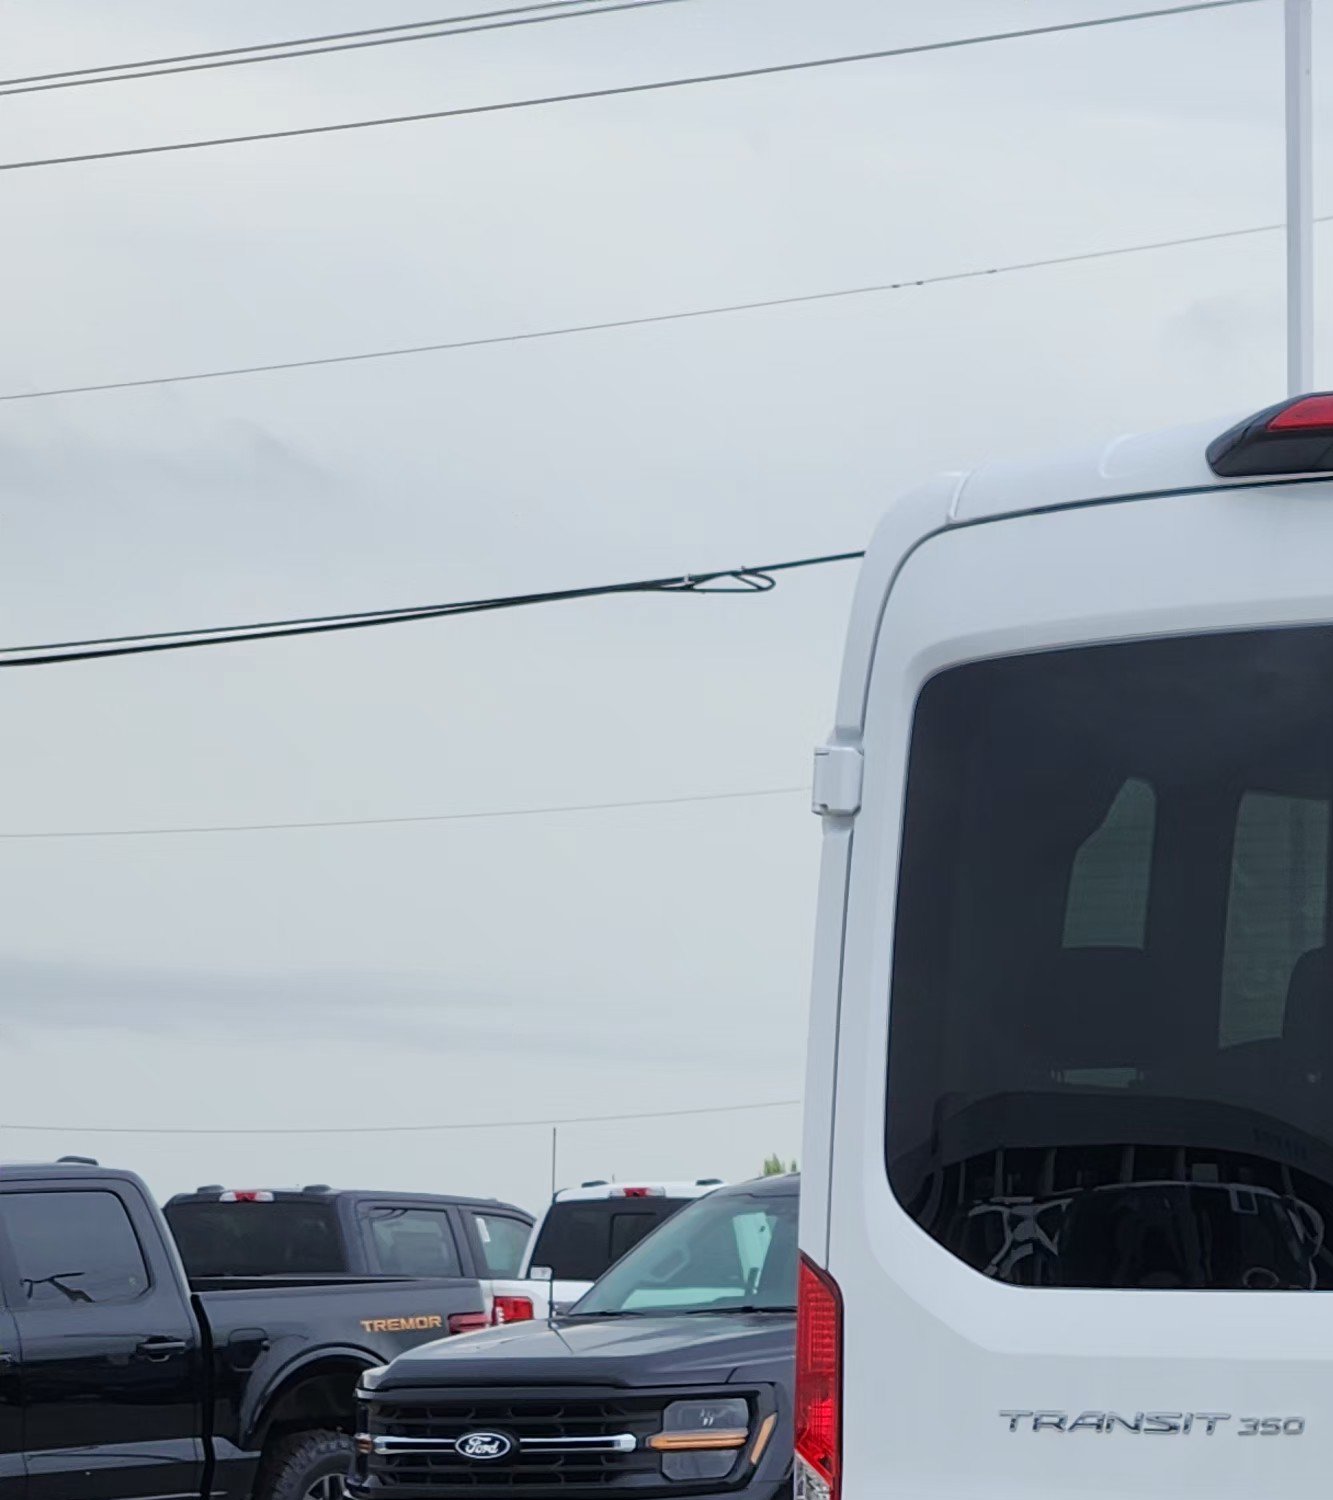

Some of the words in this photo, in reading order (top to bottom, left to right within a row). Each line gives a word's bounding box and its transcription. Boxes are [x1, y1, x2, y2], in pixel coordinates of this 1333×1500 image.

[361, 1316, 442, 1332] TREMOR
[1000, 1410, 1230, 1435] TRANSIT
[1238, 1417, 1304, 1436] 350
[465, 1436, 499, 1454] Ford
